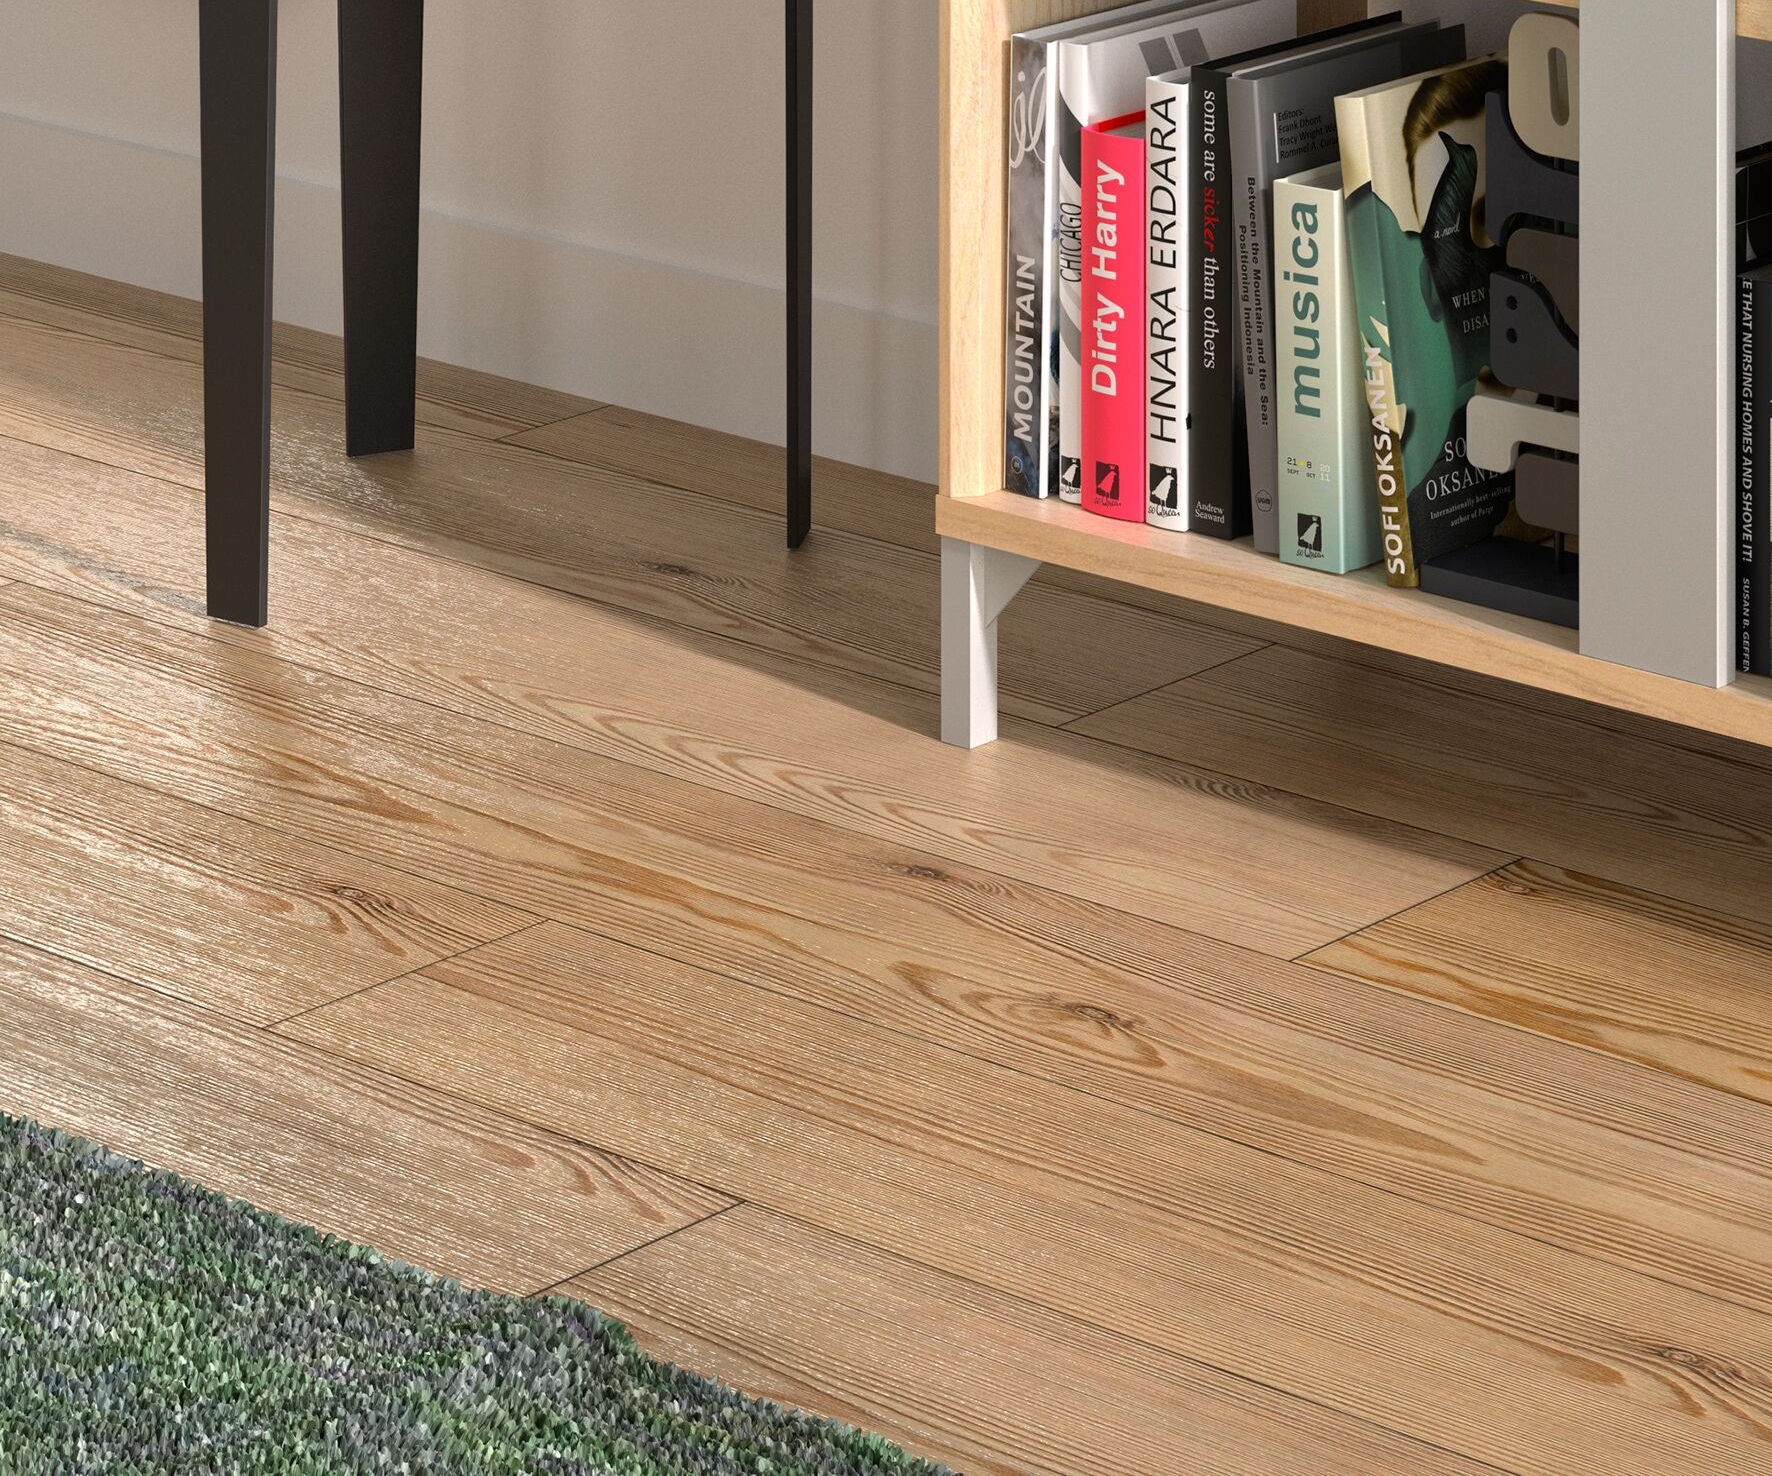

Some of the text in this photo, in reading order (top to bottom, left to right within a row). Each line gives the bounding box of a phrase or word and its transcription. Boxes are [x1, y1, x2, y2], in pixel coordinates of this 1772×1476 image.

[1278, 108, 1304, 121] Editors:
[1279, 121, 1299, 134] Frank
[1280, 135, 1298, 147] Tracy
[1299, 127, 1324, 141] Wright
[1248, 177, 1257, 237] Between
[1060, 202, 1082, 283] CHICAGO
[1204, 90, 1221, 369] some are sicker than others
[1092, 159, 1125, 397] Dirty Harry
[1150, 97, 1176, 444] HNARA ERDARA
[1239, 225, 1255, 375] Positioning Indonesia
[1253, 269, 1264, 334] Mountain
[1284, 202, 1321, 418] musica
[1452, 287, 1486, 309] WHEN
[1742, 292, 1752, 332] THAT
[1462, 314, 1490, 334] DISA
[1014, 255, 1036, 443] MOUNTAIN
[1257, 338, 1266, 365] and
[1742, 333, 1752, 399] NURSING
[1259, 369, 1268, 391] the
[1260, 395, 1269, 426] Sea:
[1742, 401, 1752, 453] HOMES
[1287, 456, 1298, 467] 21
[1364, 347, 1406, 575] SOFI OKSANEN
[1444, 437, 1466, 462] SO
[1742, 457, 1752, 490] AND
[1195, 509, 1225, 523] Seaward
[1196, 501, 1224, 515] Andrew
[1430, 485, 1511, 520] Internationally best-selling
[1450, 513, 1470, 528] author
[1470, 509, 1478, 519] of
[1742, 491, 1752, 541] SHOVE
[1742, 542, 1752, 563] IT!
[1742, 578, 1750, 616] SUSAN
[1742, 618, 1750, 630] B.
